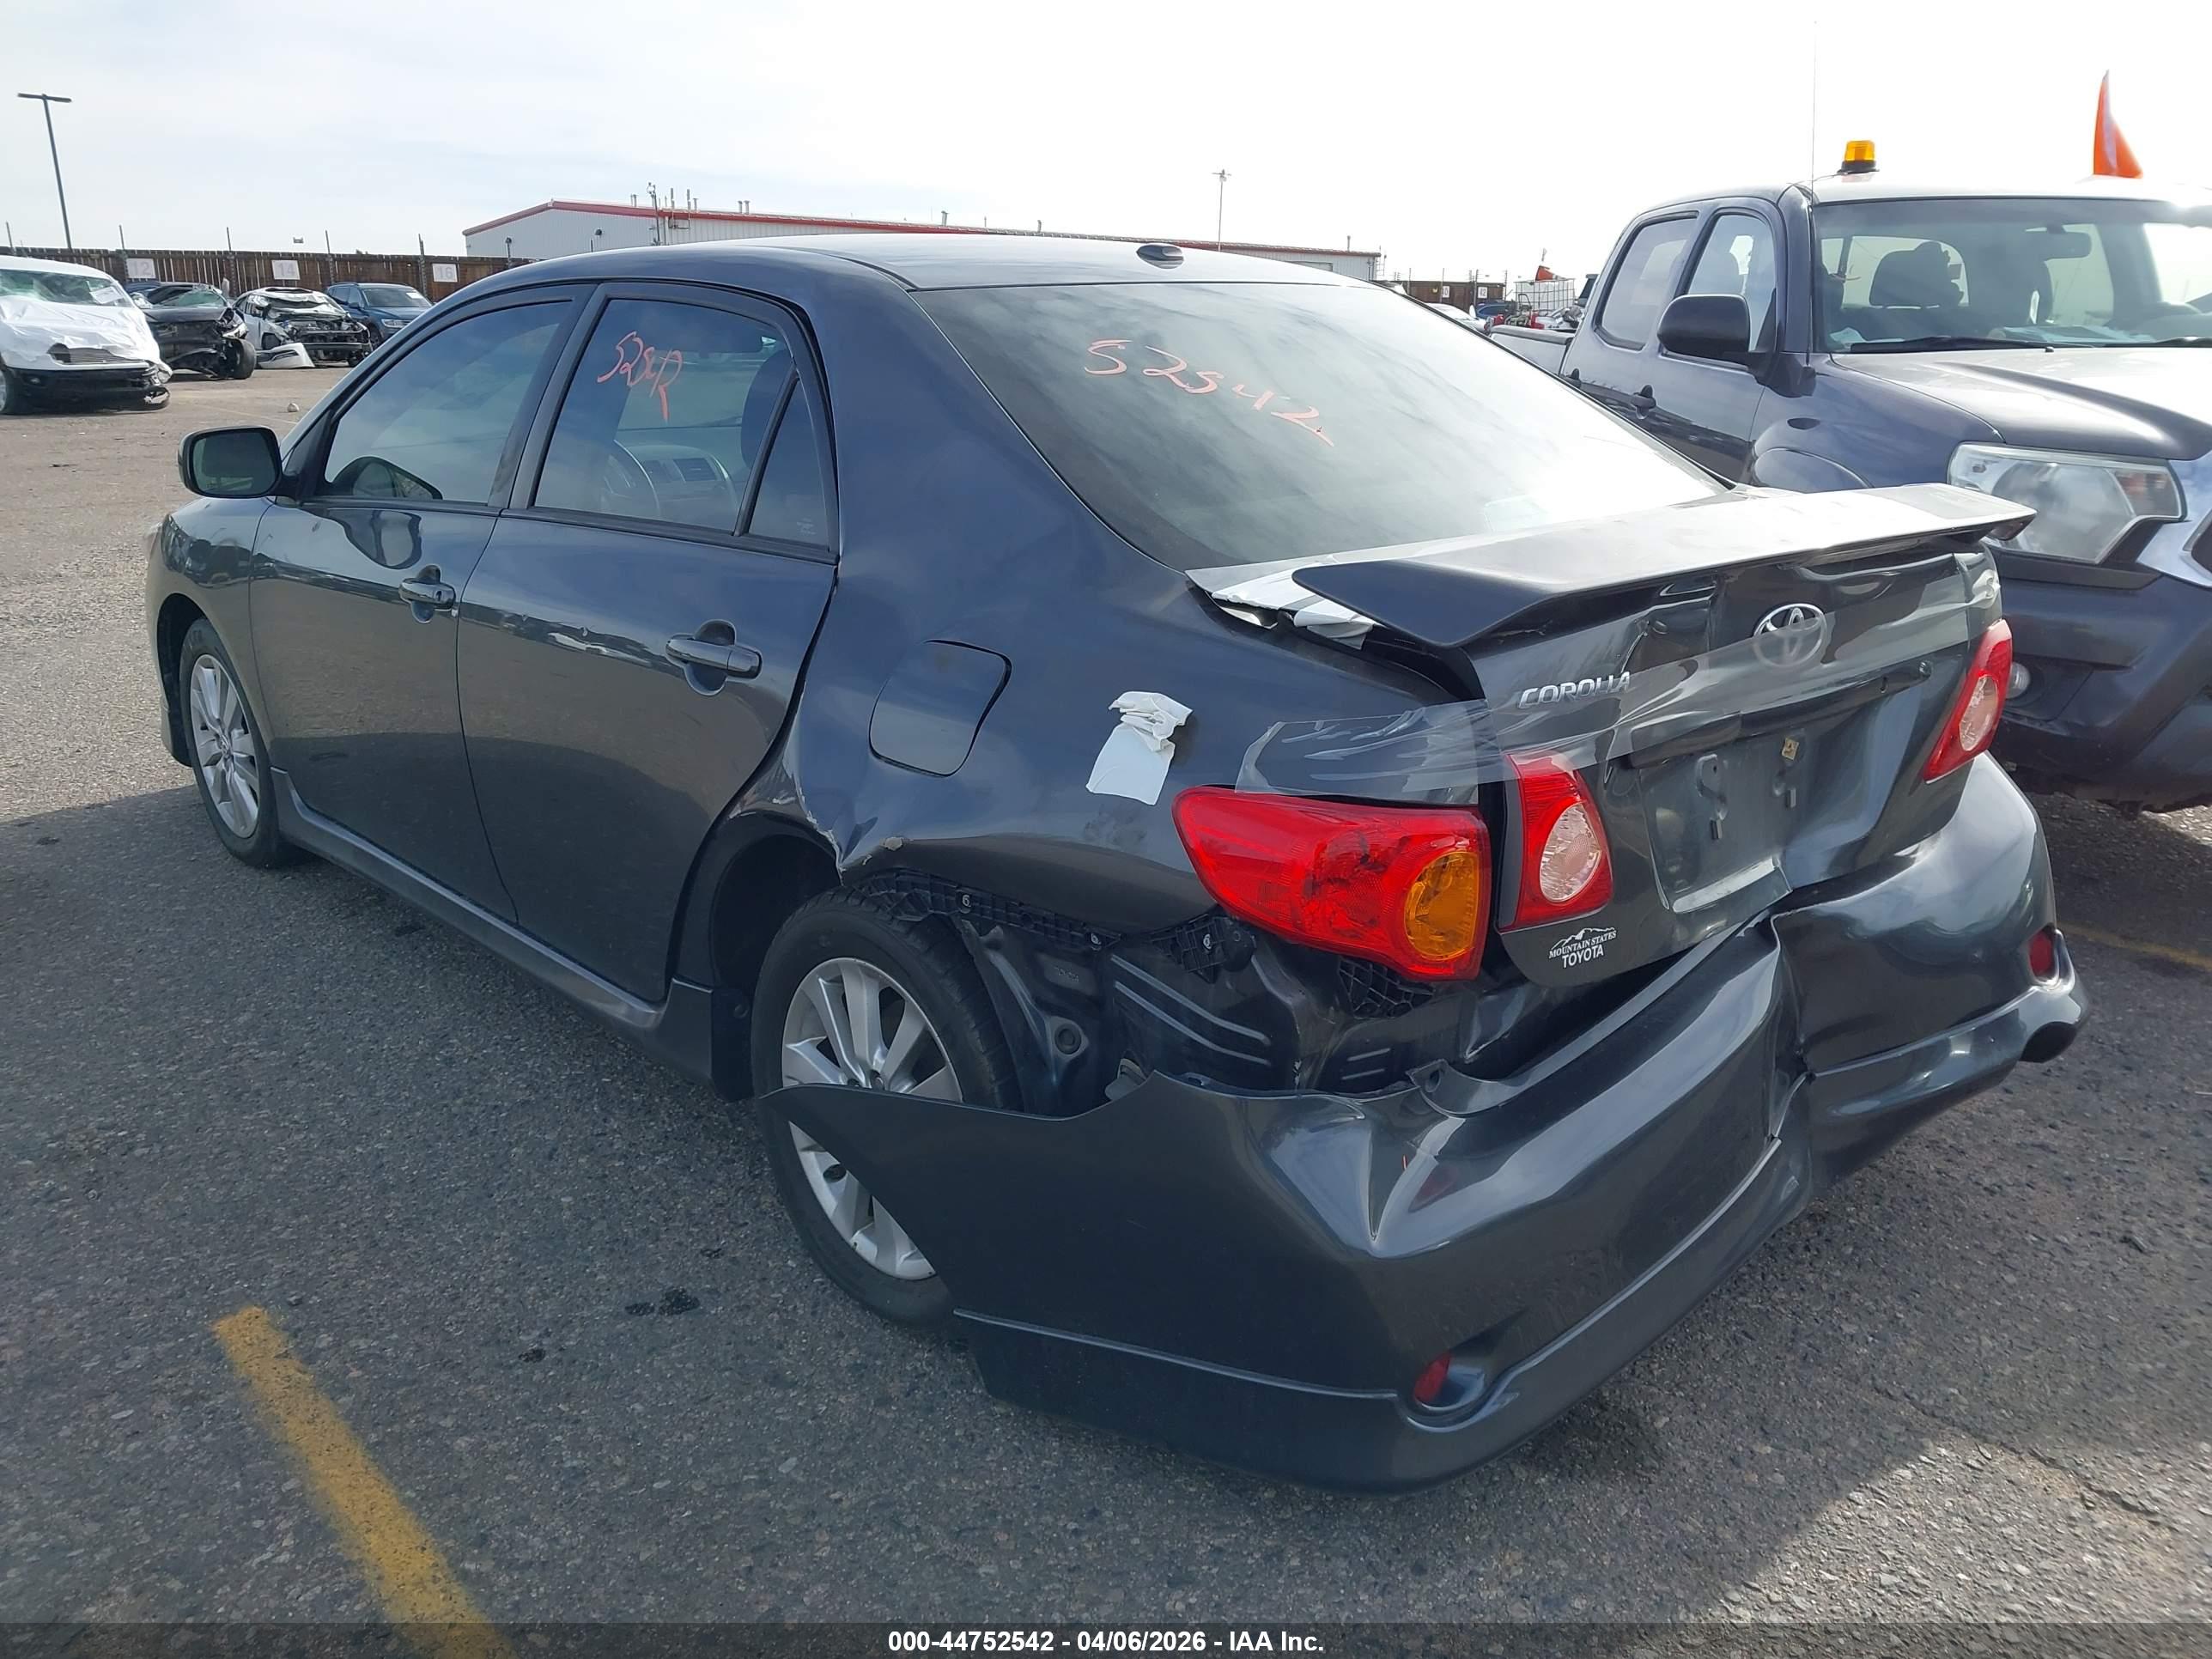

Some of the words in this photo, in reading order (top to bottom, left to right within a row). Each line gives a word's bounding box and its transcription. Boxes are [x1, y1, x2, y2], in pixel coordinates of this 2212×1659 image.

[131, 261, 152, 276] 12
[277, 263, 296, 276] 14
[436, 265, 453, 279] 16
[1518, 671, 1631, 709] COROLLA
[1548, 938, 1591, 959] MOUNTAIN
[1590, 930, 1617, 945] STATES
[1561, 944, 1604, 969] TOYOTA
